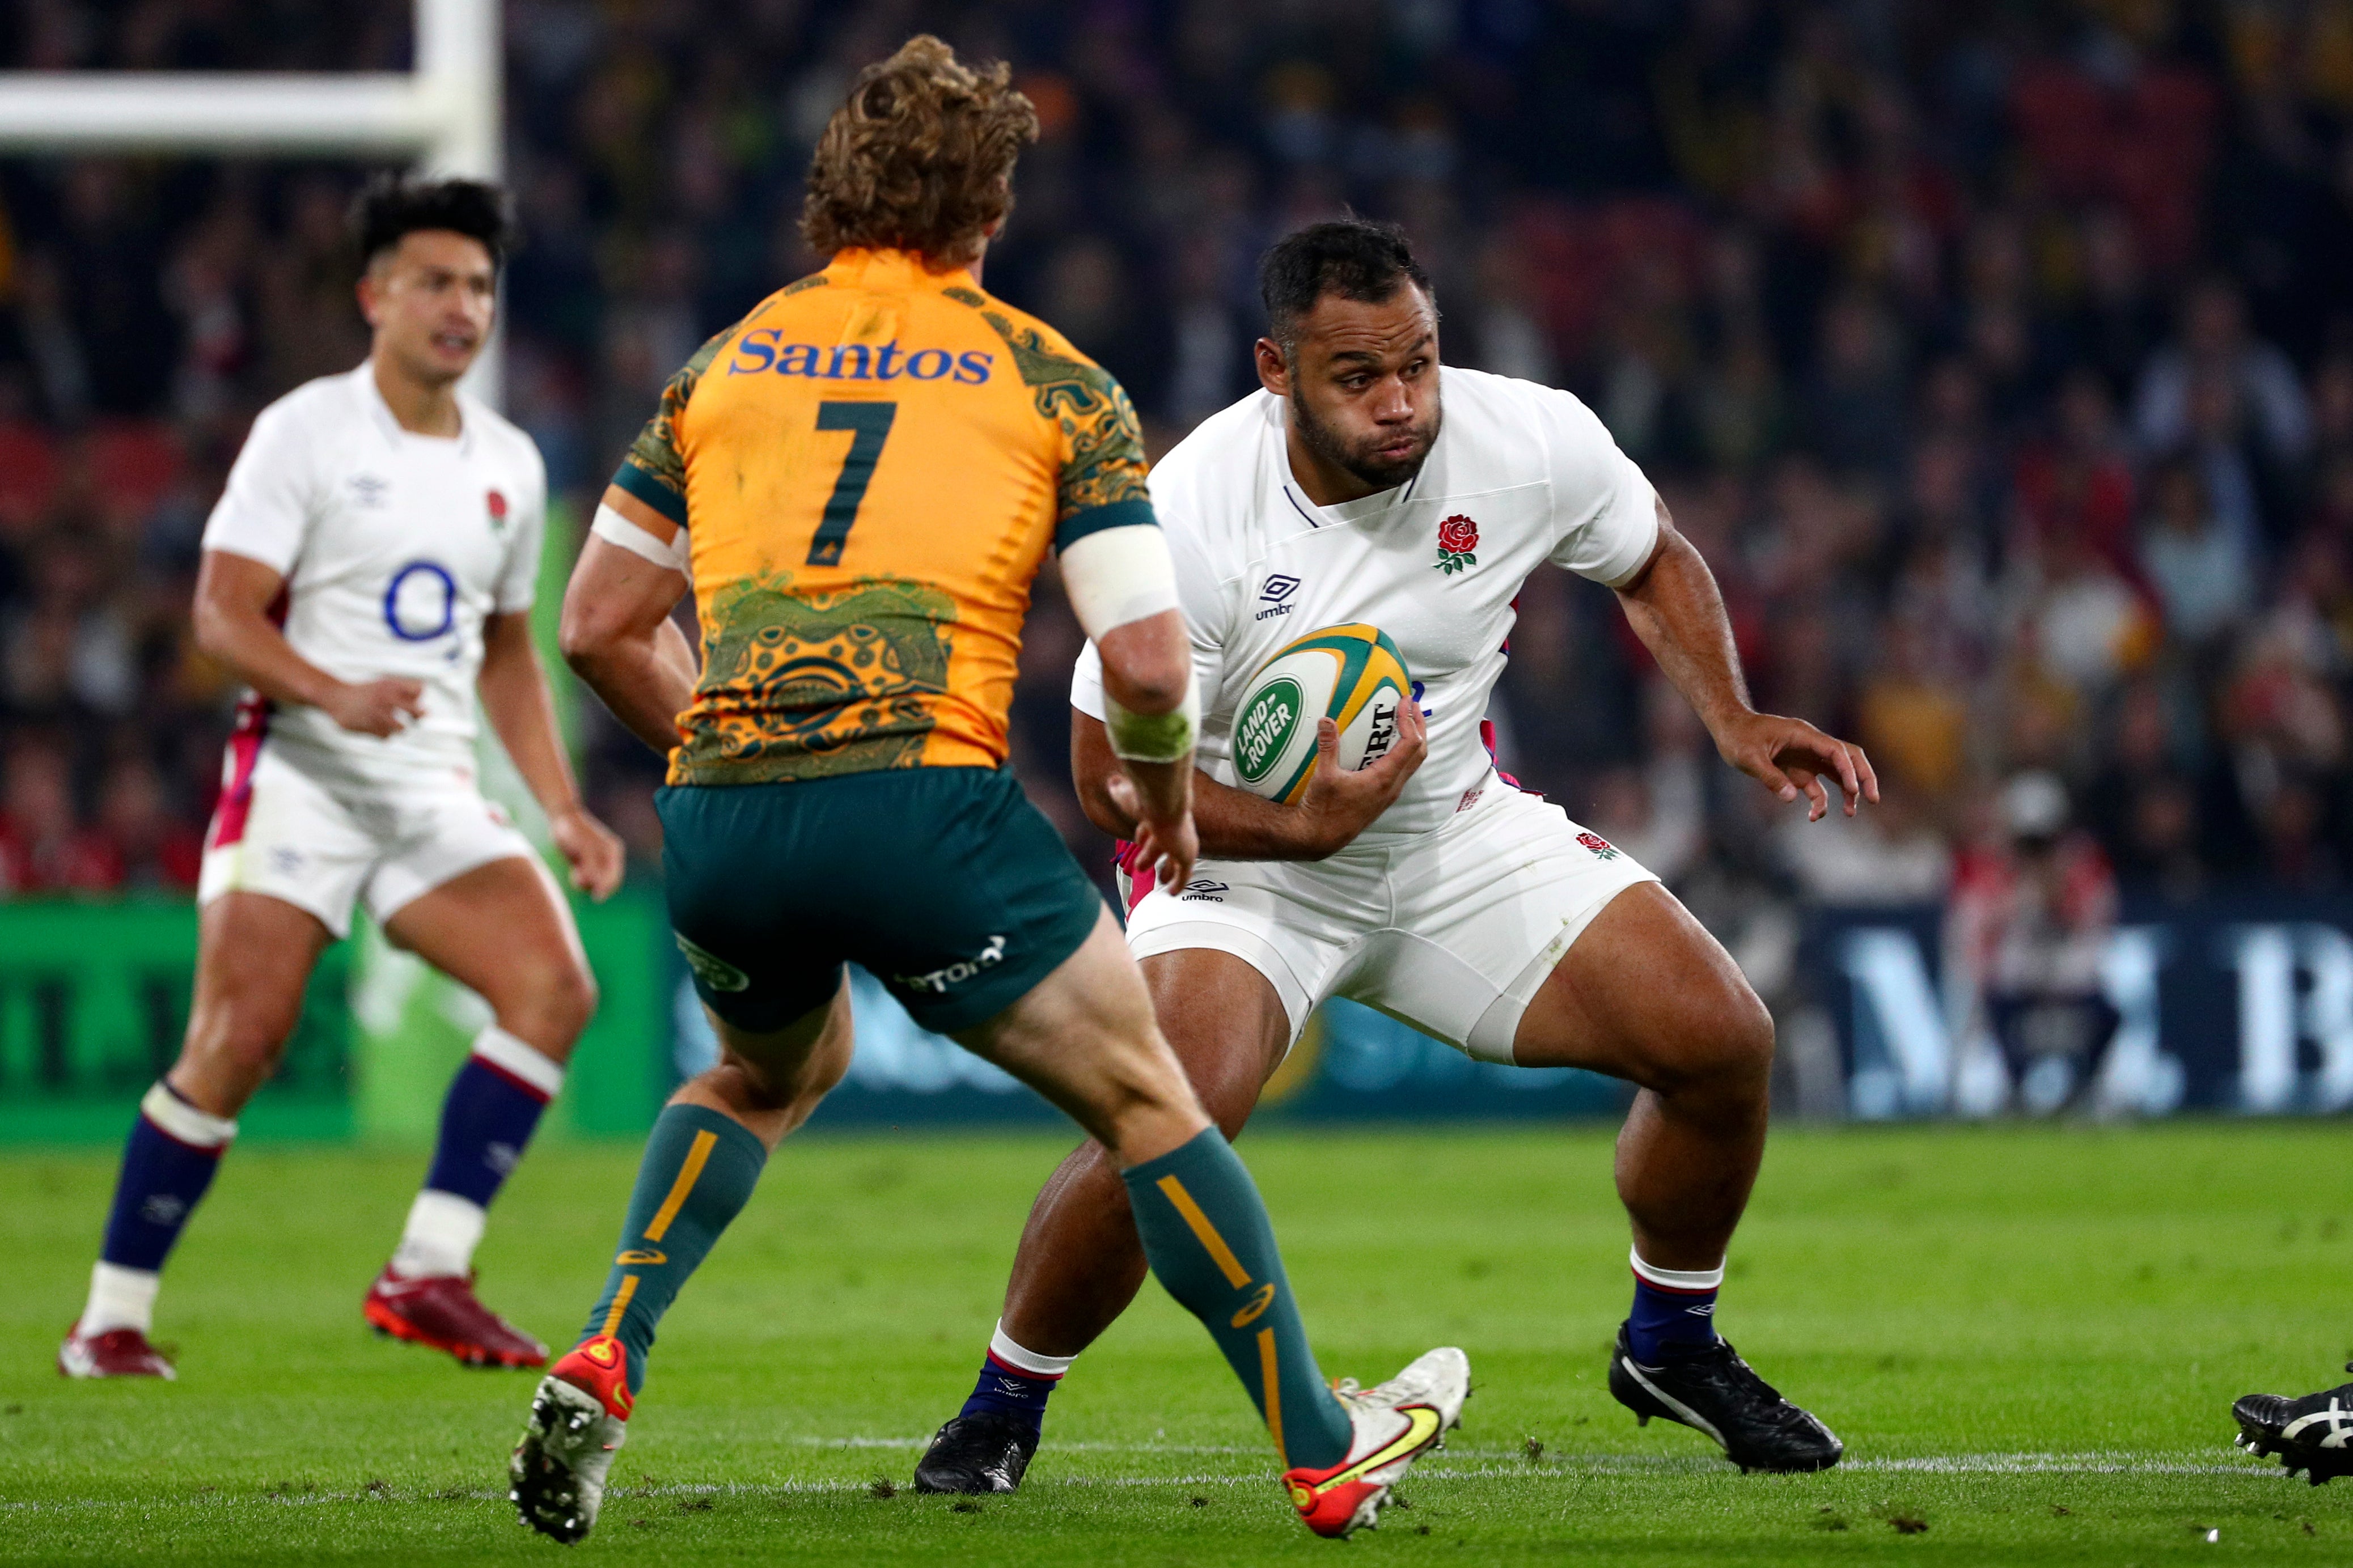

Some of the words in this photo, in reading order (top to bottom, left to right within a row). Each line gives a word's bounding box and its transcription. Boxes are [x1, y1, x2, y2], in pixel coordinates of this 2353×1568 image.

[728, 328, 994, 385] Santos
[806, 401, 898, 566] 7
[1255, 603, 1293, 621] umbr
[1182, 893, 1224, 902] umbro
